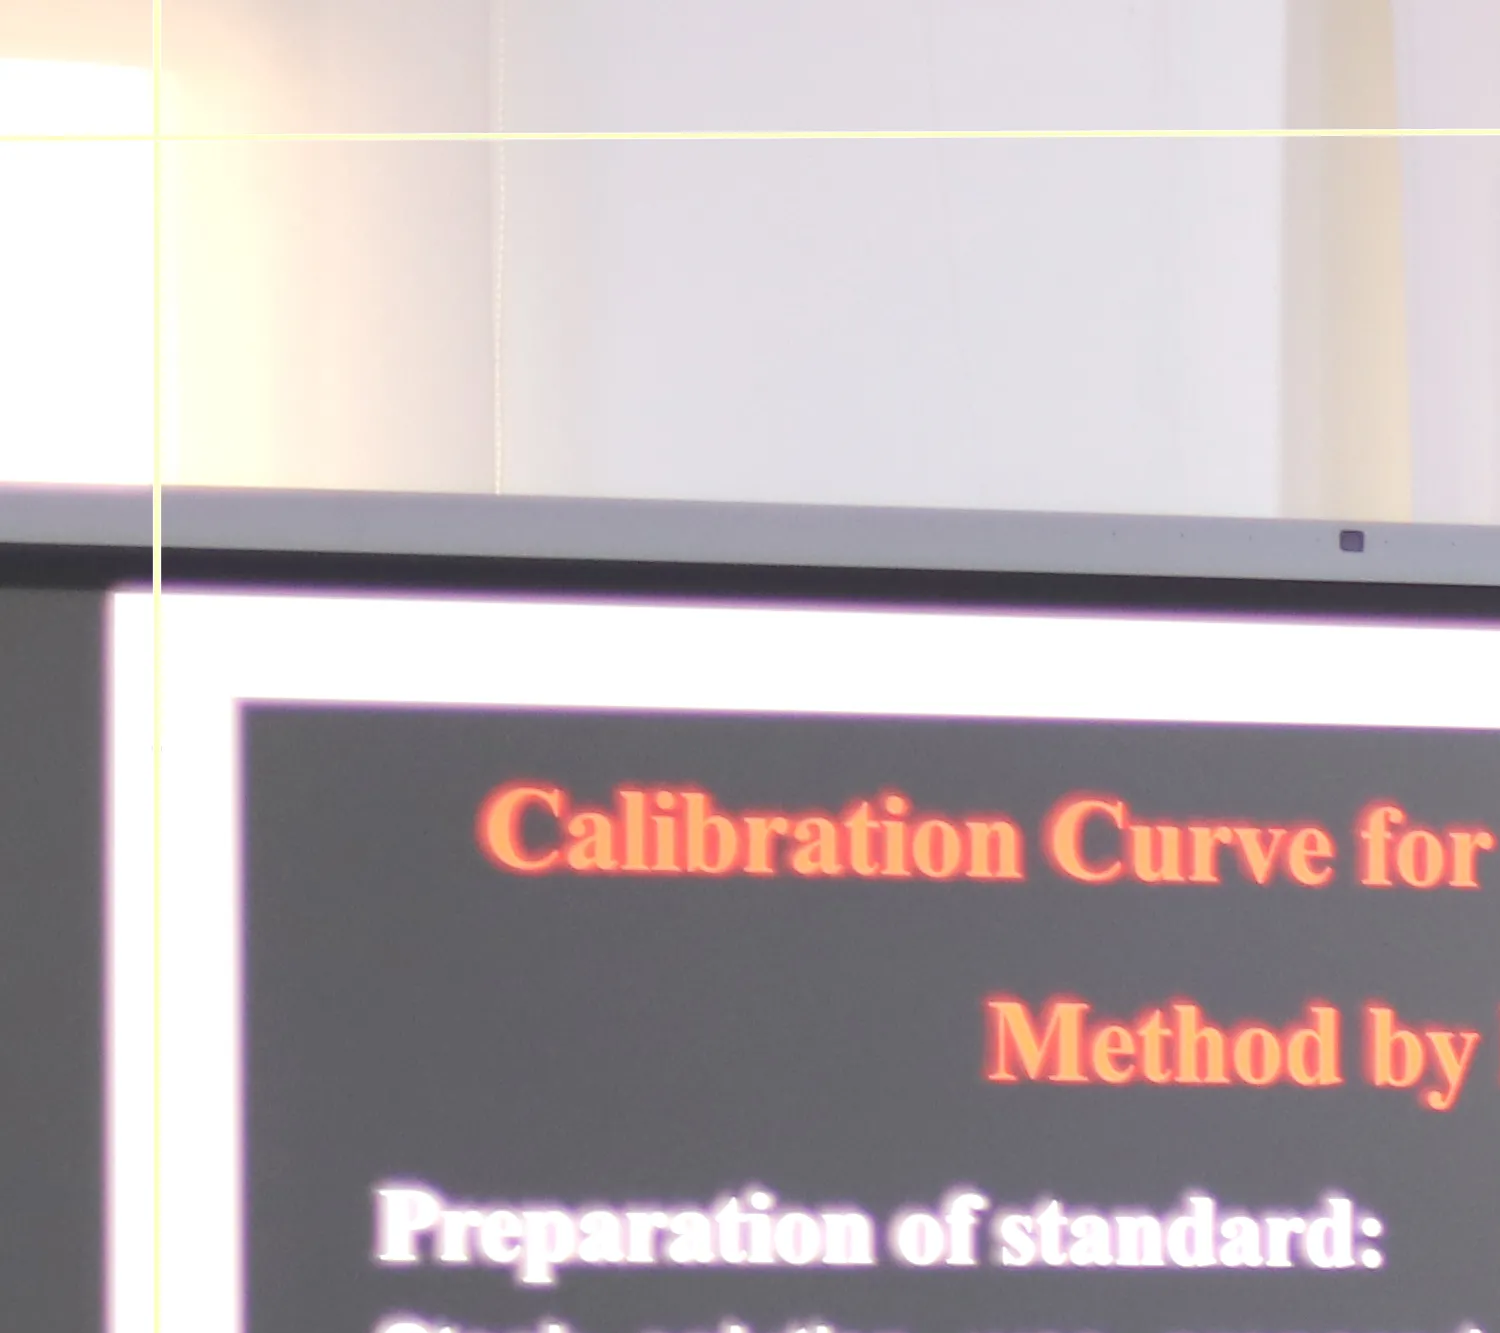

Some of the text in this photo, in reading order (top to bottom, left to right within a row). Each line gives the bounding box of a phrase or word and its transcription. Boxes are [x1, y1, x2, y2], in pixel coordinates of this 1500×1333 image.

[480, 786, 1023, 879] Calibration
[1045, 796, 1334, 885] Curve
[1357, 803, 1495, 888] for
[987, 997, 1343, 1085] Method
[1365, 1004, 1480, 1110] by
[378, 1185, 1382, 1283] Preparation of standard:
